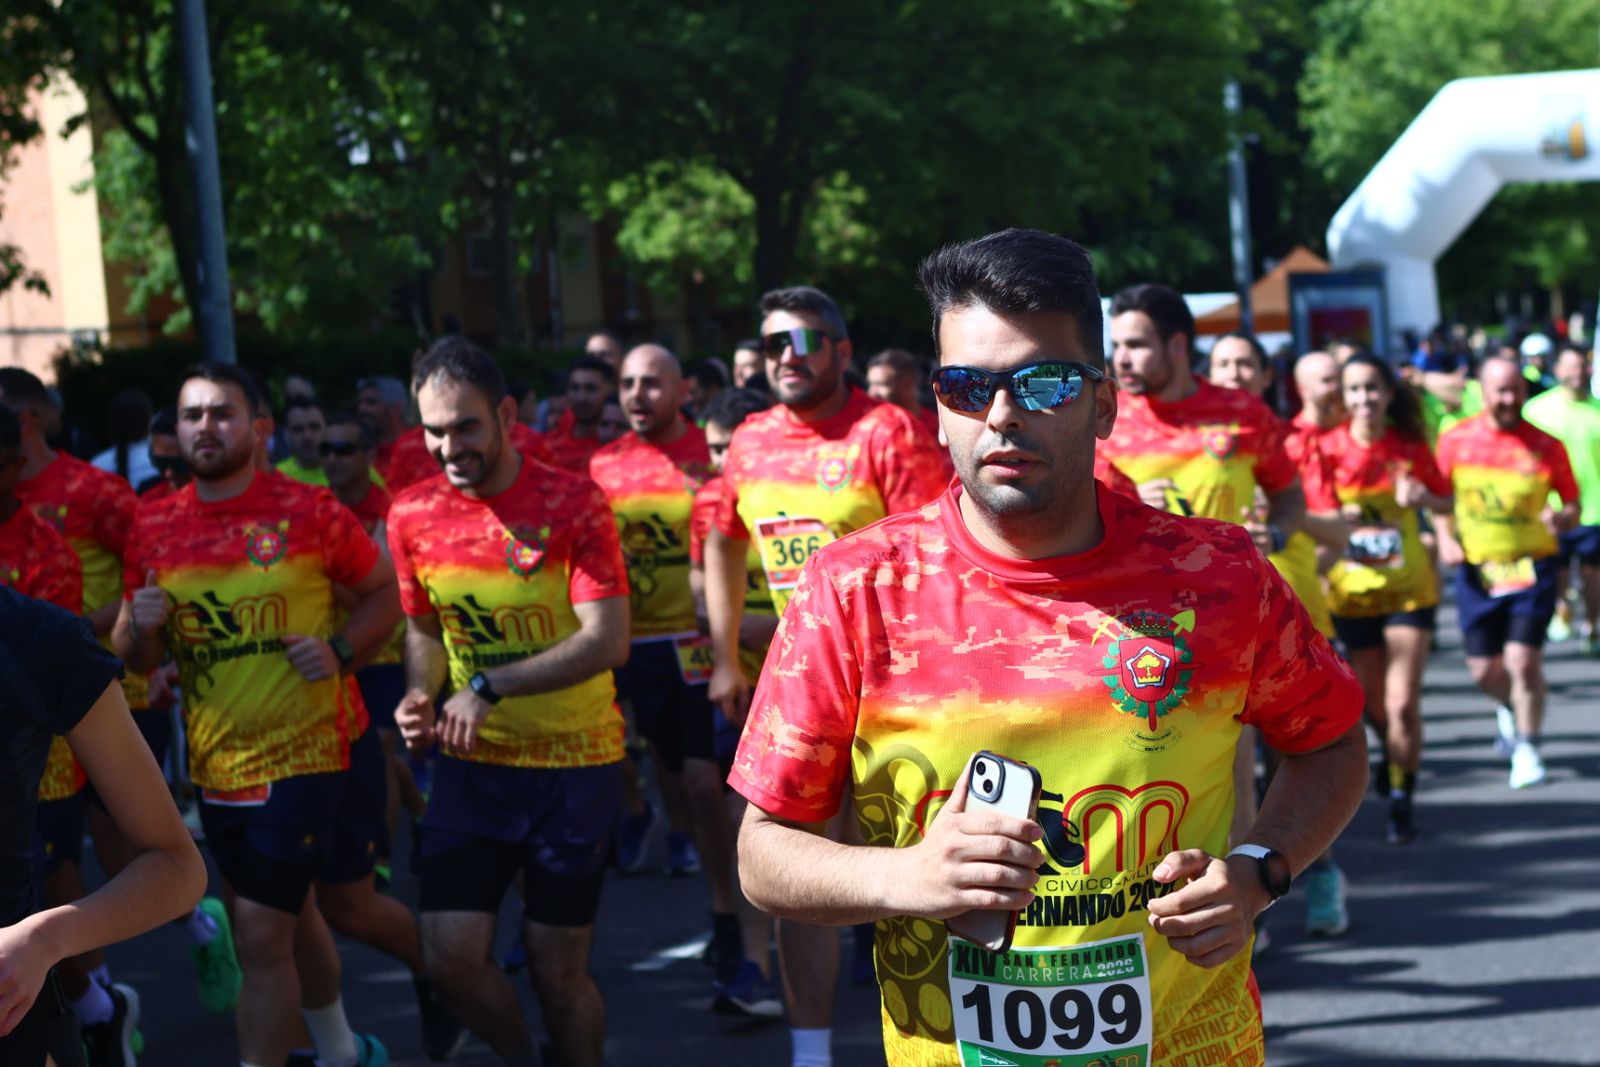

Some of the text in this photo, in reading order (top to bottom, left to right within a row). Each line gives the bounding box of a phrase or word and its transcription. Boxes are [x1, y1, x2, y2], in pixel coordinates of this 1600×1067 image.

[1016, 890, 1126, 927] ERNANDO
[955, 942, 1137, 977] XIV SAN FERNANDO
[1003, 964, 1093, 982] CARRERA
[962, 983, 1142, 1050] 1099
